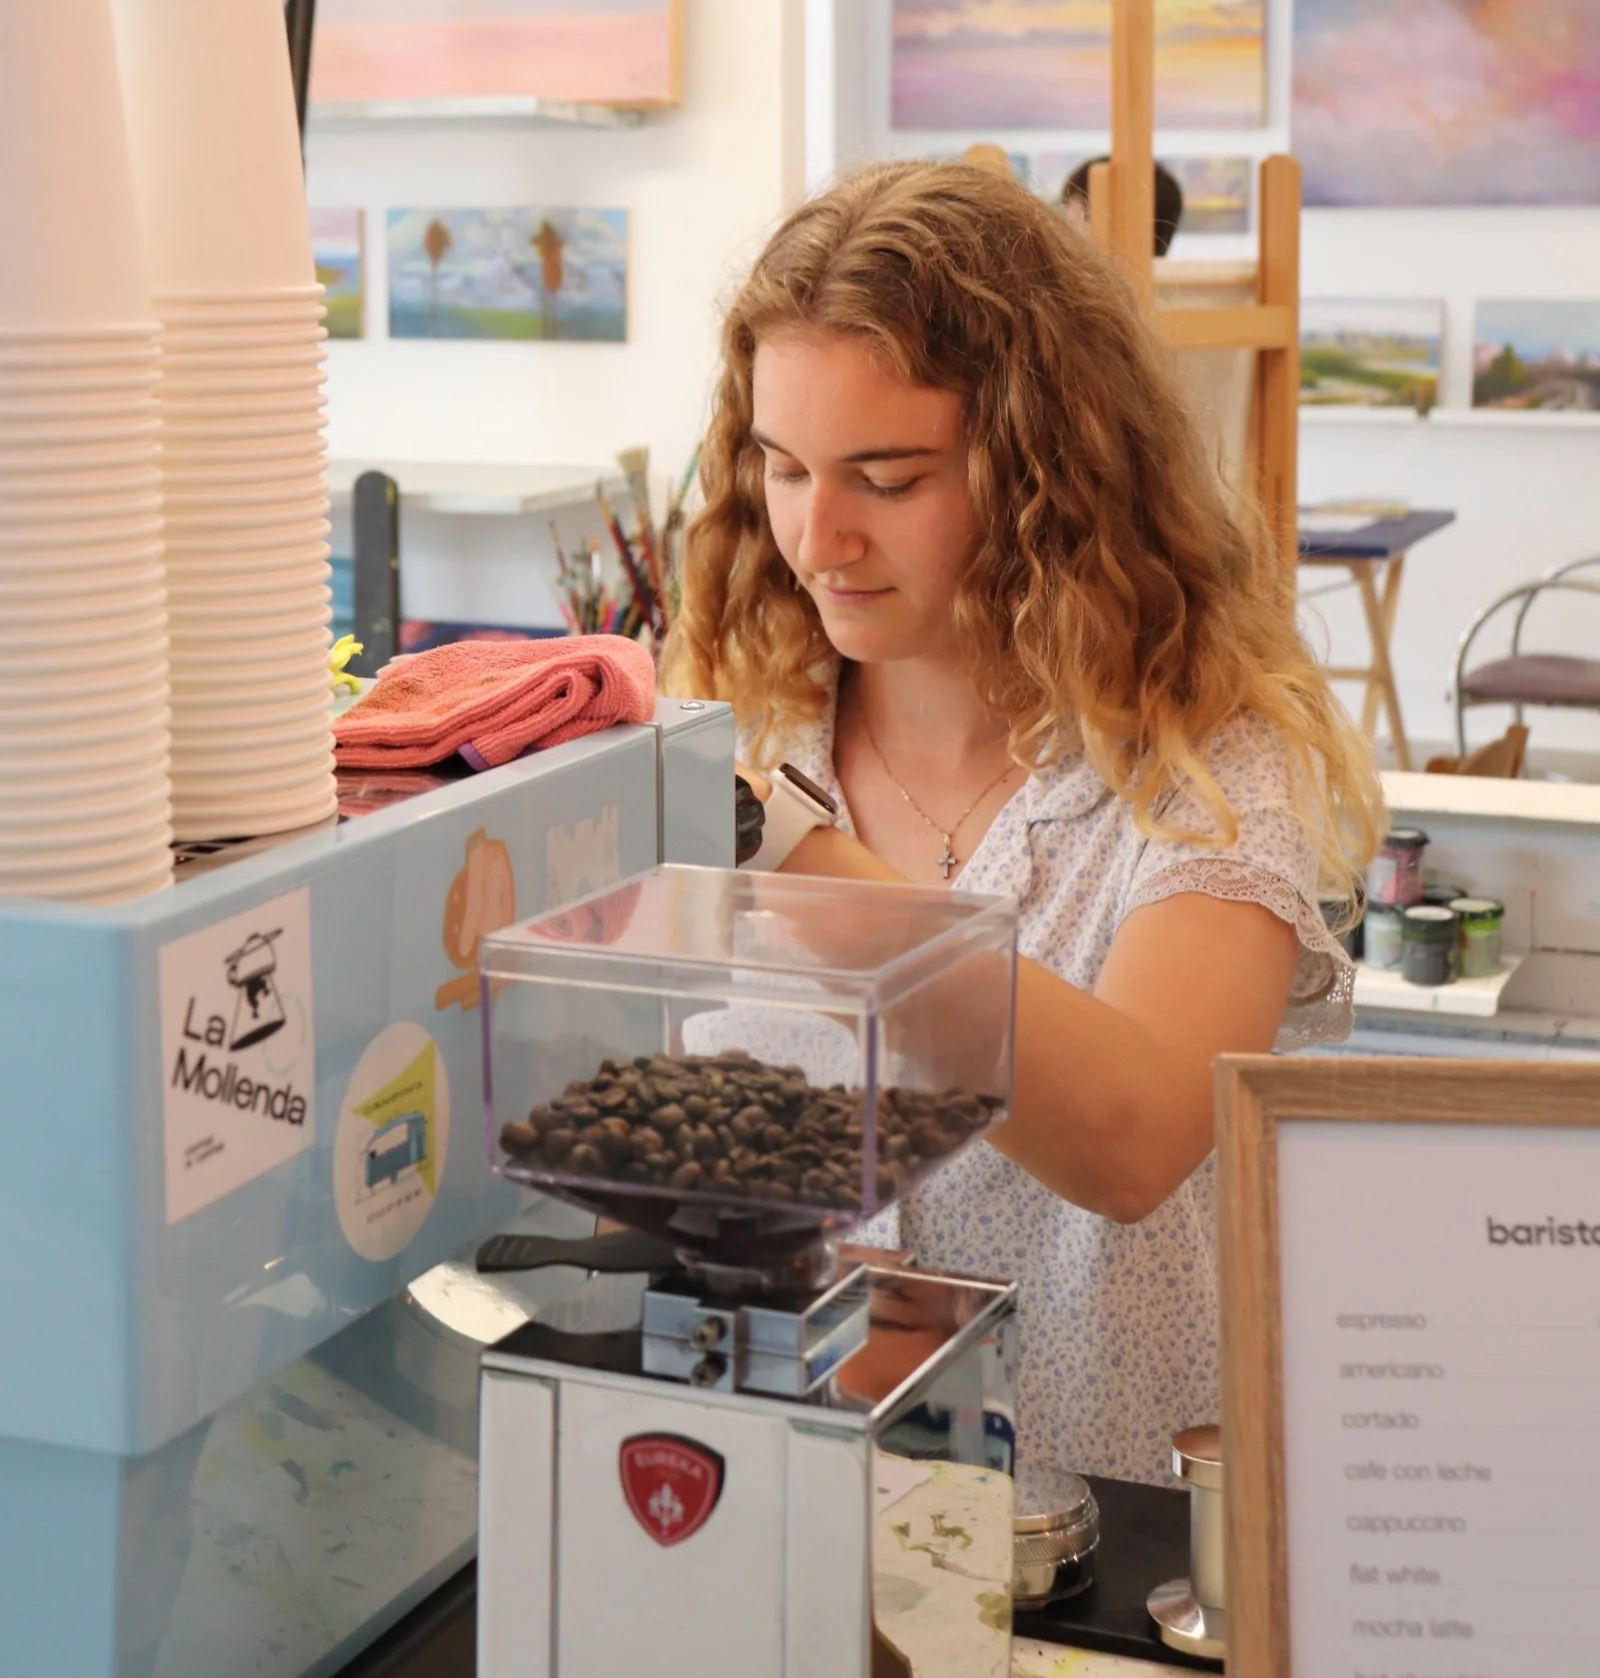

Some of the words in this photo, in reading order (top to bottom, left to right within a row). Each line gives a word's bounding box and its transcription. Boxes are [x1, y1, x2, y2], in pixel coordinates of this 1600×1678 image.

[183, 996, 226, 1048] La
[172, 1046, 307, 1127] Mollenda
[1336, 1313, 1427, 1330] espresso
[1339, 1362, 1445, 1380] americano
[1340, 1410, 1421, 1429] cortado
[1392, 1463, 1430, 1481] con
[1436, 1461, 1493, 1482] leche
[1346, 1514, 1467, 1534] cappuccino
[1348, 1561, 1380, 1585] flat
[1384, 1564, 1442, 1586] white
[1351, 1617, 1424, 1638] mocha
